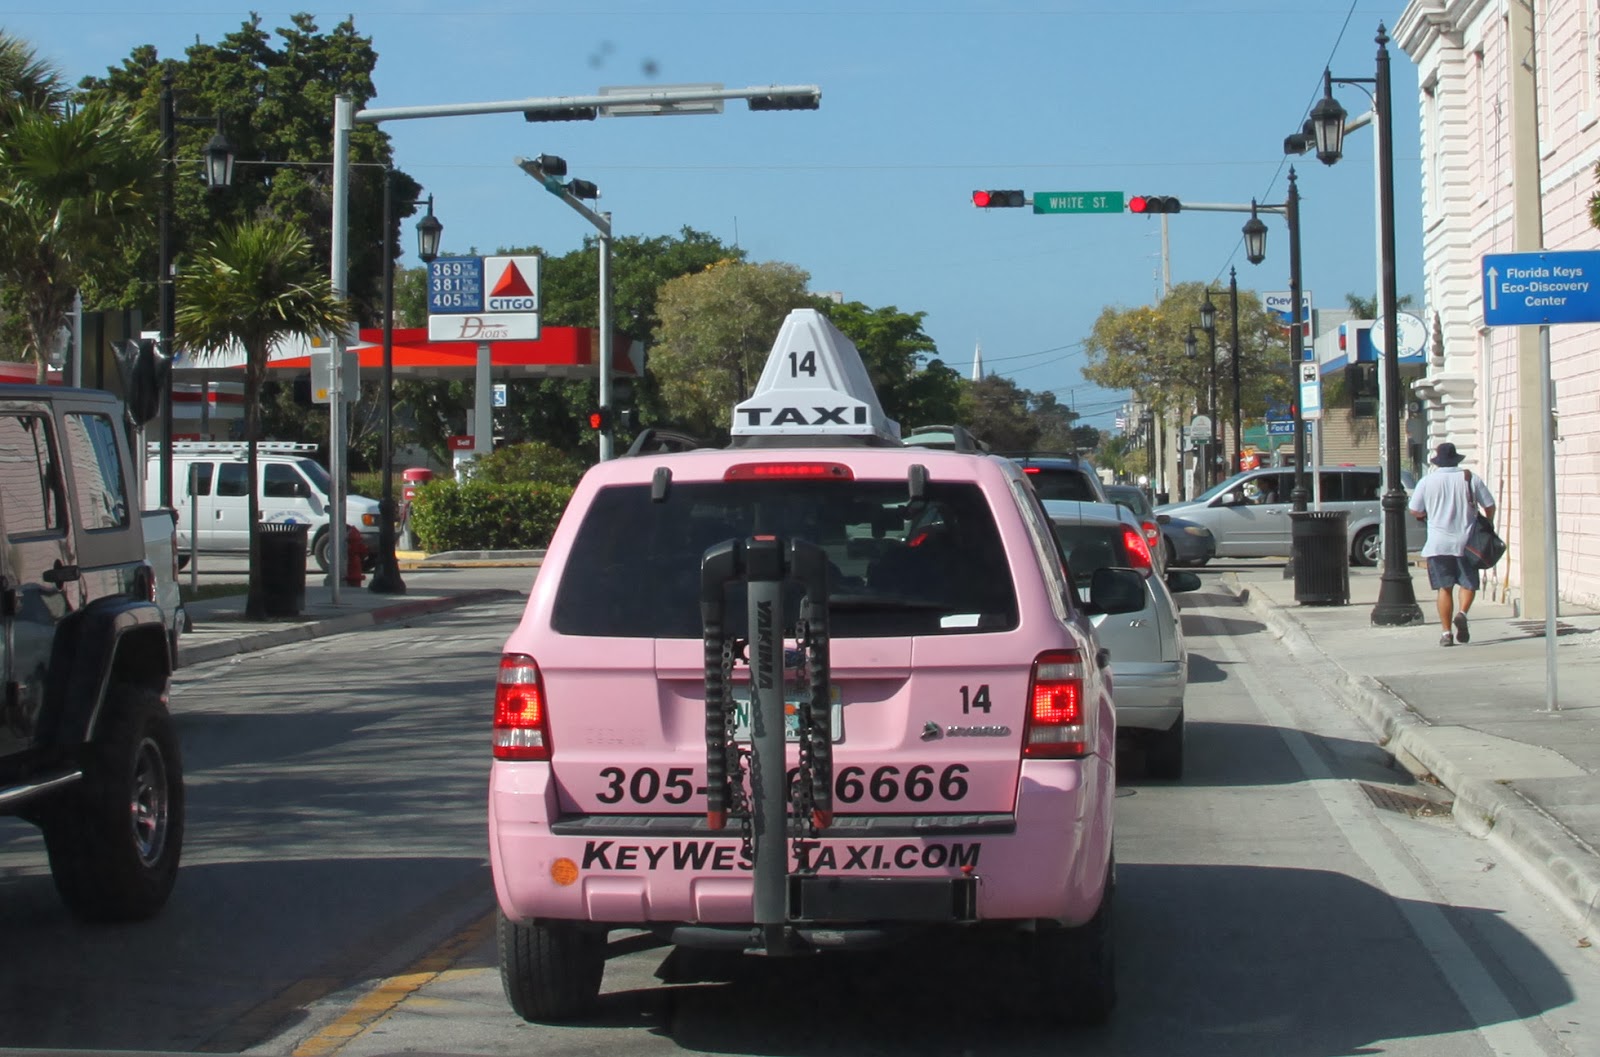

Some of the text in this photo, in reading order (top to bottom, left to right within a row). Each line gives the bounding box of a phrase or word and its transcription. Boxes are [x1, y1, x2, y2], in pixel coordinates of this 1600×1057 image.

[1049, 196, 1085, 209] WHITE
[433, 263, 462, 276] 369
[1506, 266, 1583, 279] Florida Keys
[433, 278, 461, 292] 381
[1501, 281, 1590, 294] Eco-Discovery
[433, 294, 462, 307] 405
[489, 298, 535, 310] CITGO
[1266, 296, 1309, 306] Chevn
[1525, 295, 1567, 307] Center
[457, 316, 509, 339] Dion's
[788, 350, 817, 378] 14
[737, 406, 867, 426] TAXI
[756, 600, 773, 689] YAKIMA
[959, 684, 992, 715] 14
